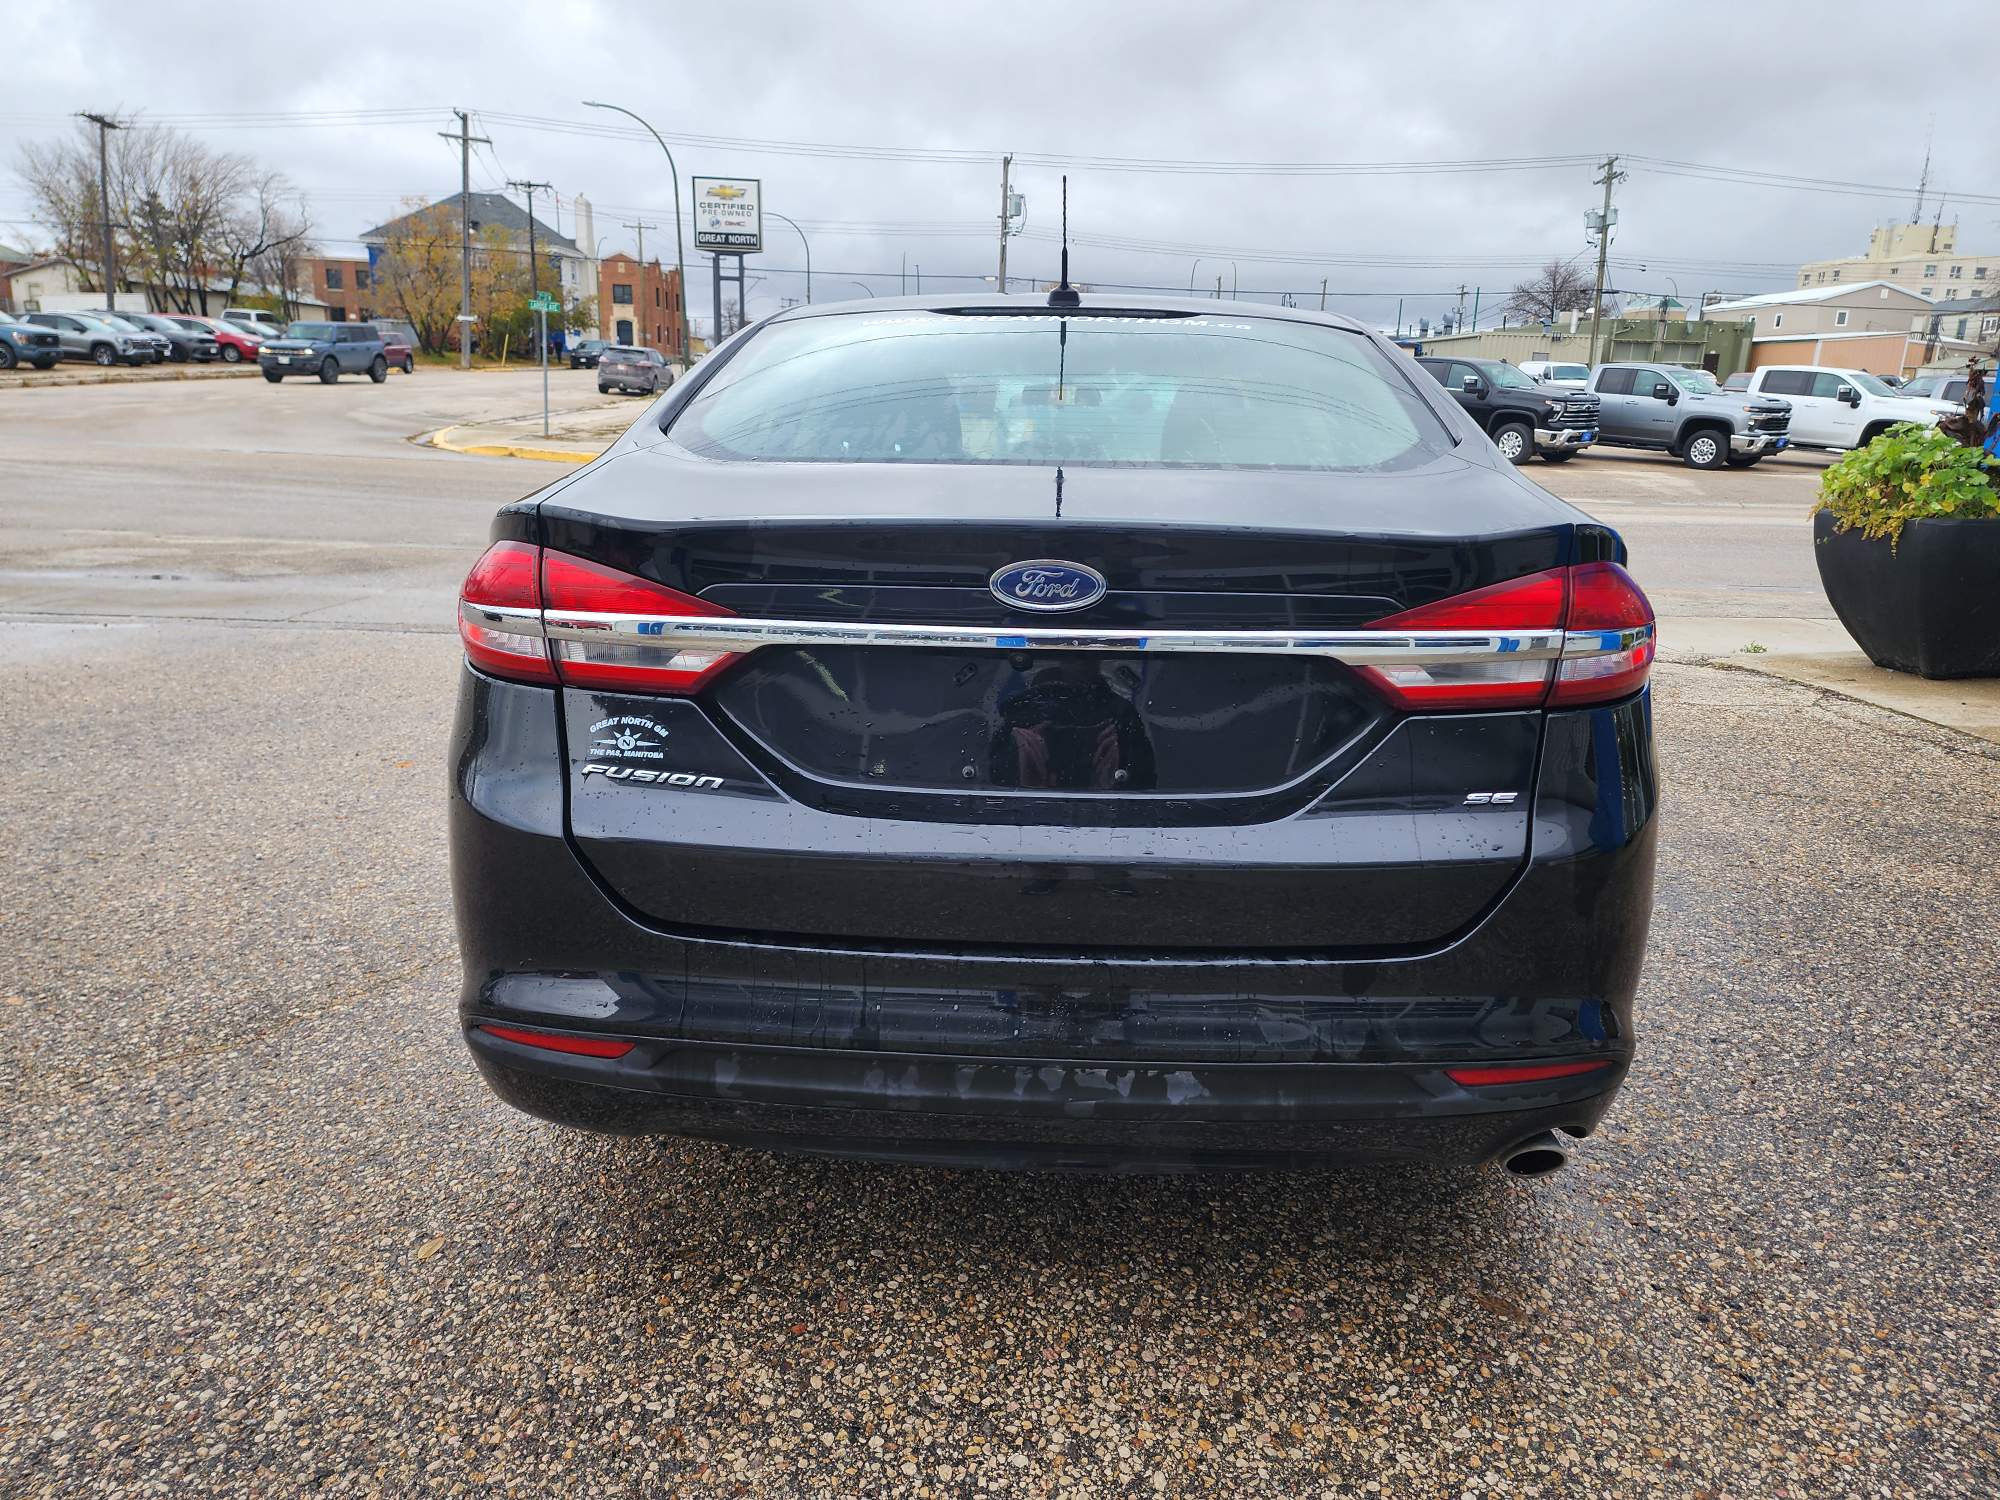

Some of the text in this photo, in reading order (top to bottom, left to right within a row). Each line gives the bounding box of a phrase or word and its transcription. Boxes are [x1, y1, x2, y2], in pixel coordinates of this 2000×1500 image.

[699, 202, 754, 211] CERTIFIED
[702, 209, 752, 217] PRE-OWNED
[700, 234, 757, 244] GREAT NORTH
[1015, 569, 1080, 598] Ford
[589, 716, 670, 738] GREAT NORTH GM
[589, 748, 664, 759] THE PAS, MANITOBA
[1462, 792, 1518, 805] SE
